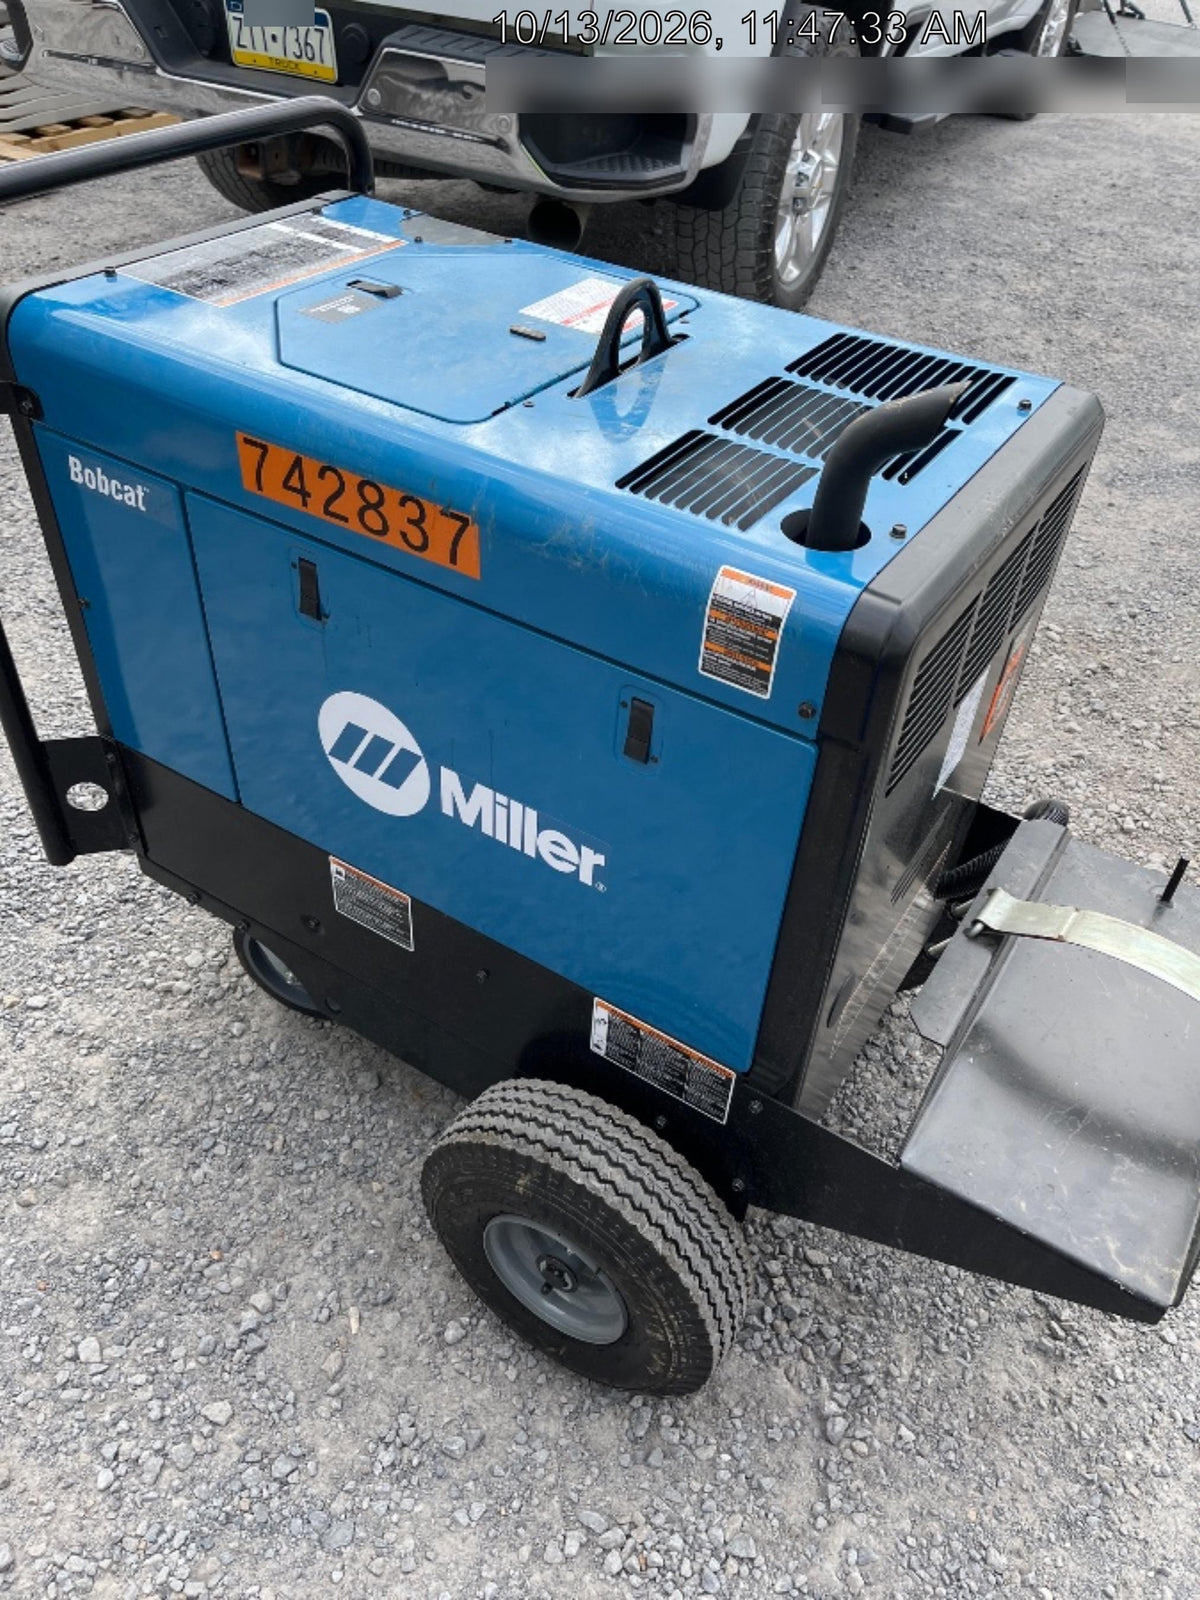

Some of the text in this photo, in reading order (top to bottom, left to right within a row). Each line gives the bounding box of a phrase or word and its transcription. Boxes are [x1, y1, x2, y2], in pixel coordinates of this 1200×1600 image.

[68, 453, 147, 512] Bobcat
[243, 436, 470, 566] 742837
[440, 765, 605, 887] Miller
